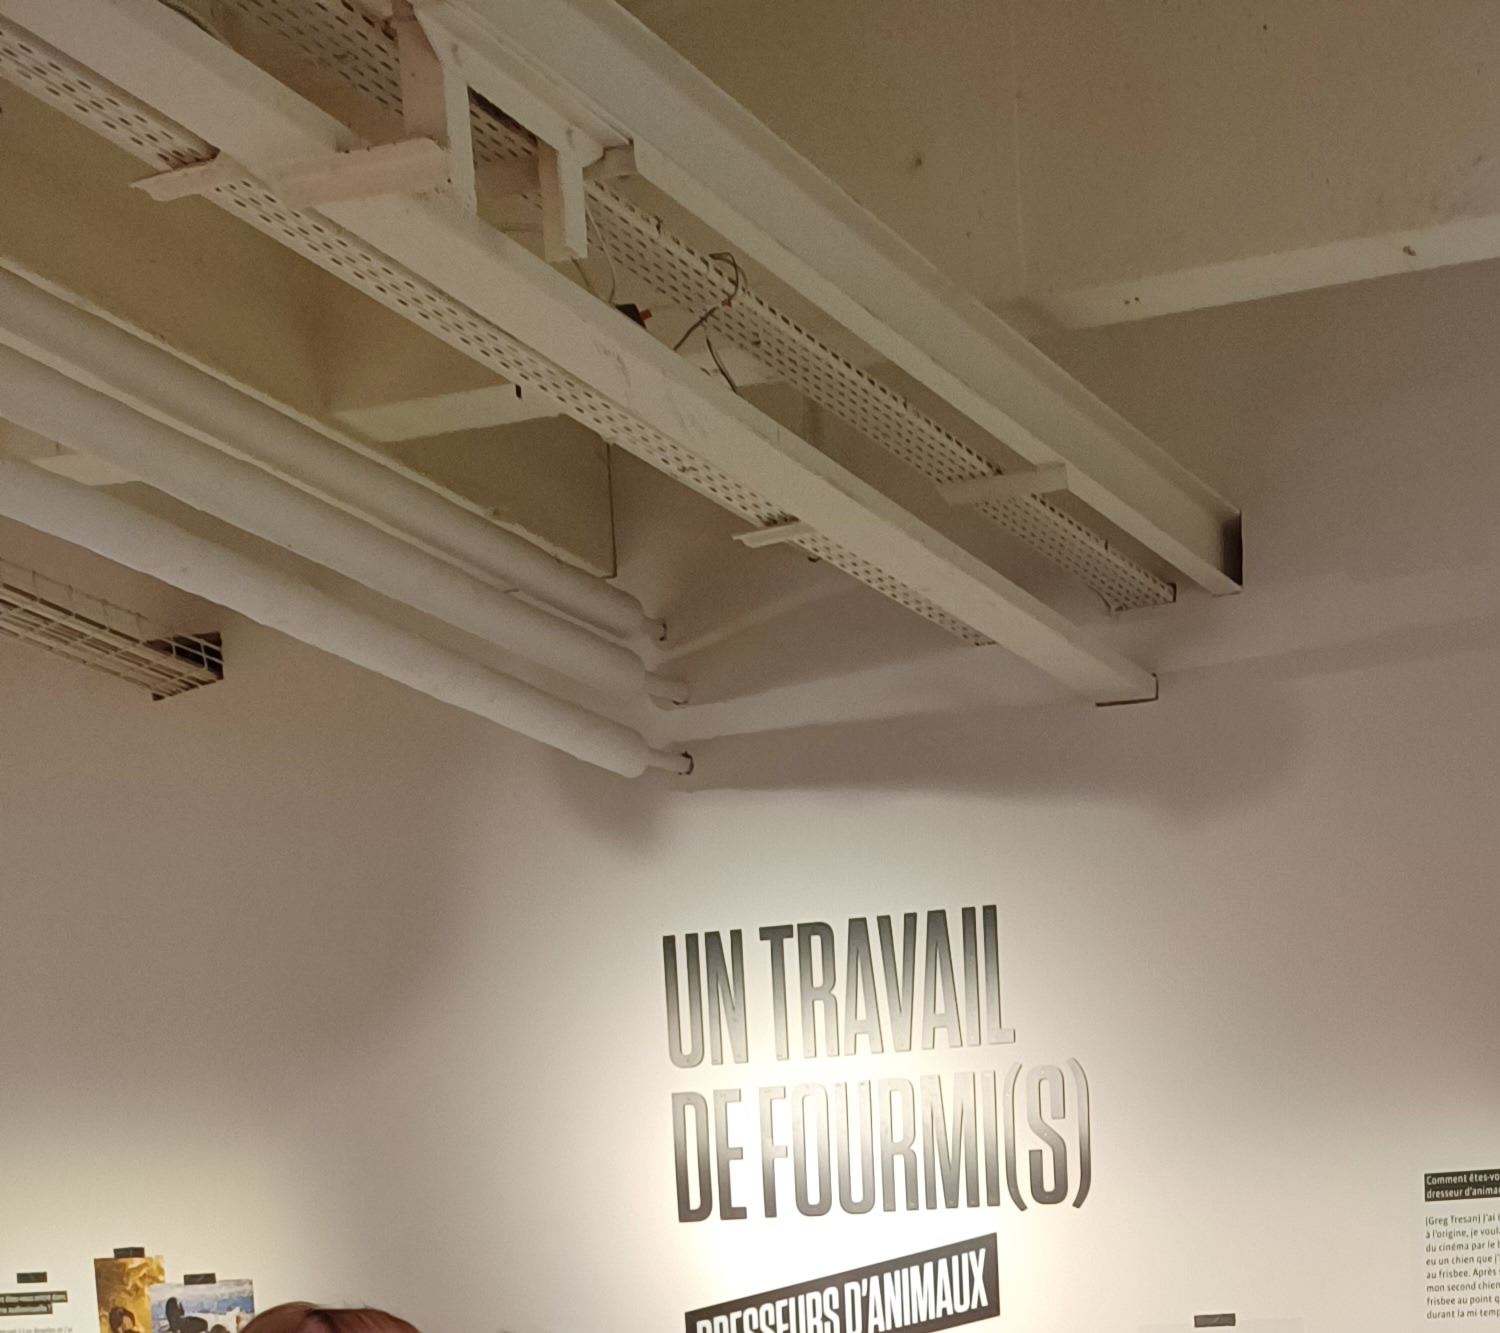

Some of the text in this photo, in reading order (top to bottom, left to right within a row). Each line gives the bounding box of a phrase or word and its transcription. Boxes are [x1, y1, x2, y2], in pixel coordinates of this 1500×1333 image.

[662, 905, 1016, 1068] UN TRAVAIL
[671, 1058, 1092, 1223] DE FOURMI(S)
[1426, 1174, 1467, 1185] Comment
[1426, 1189, 1463, 1199] dresseur
